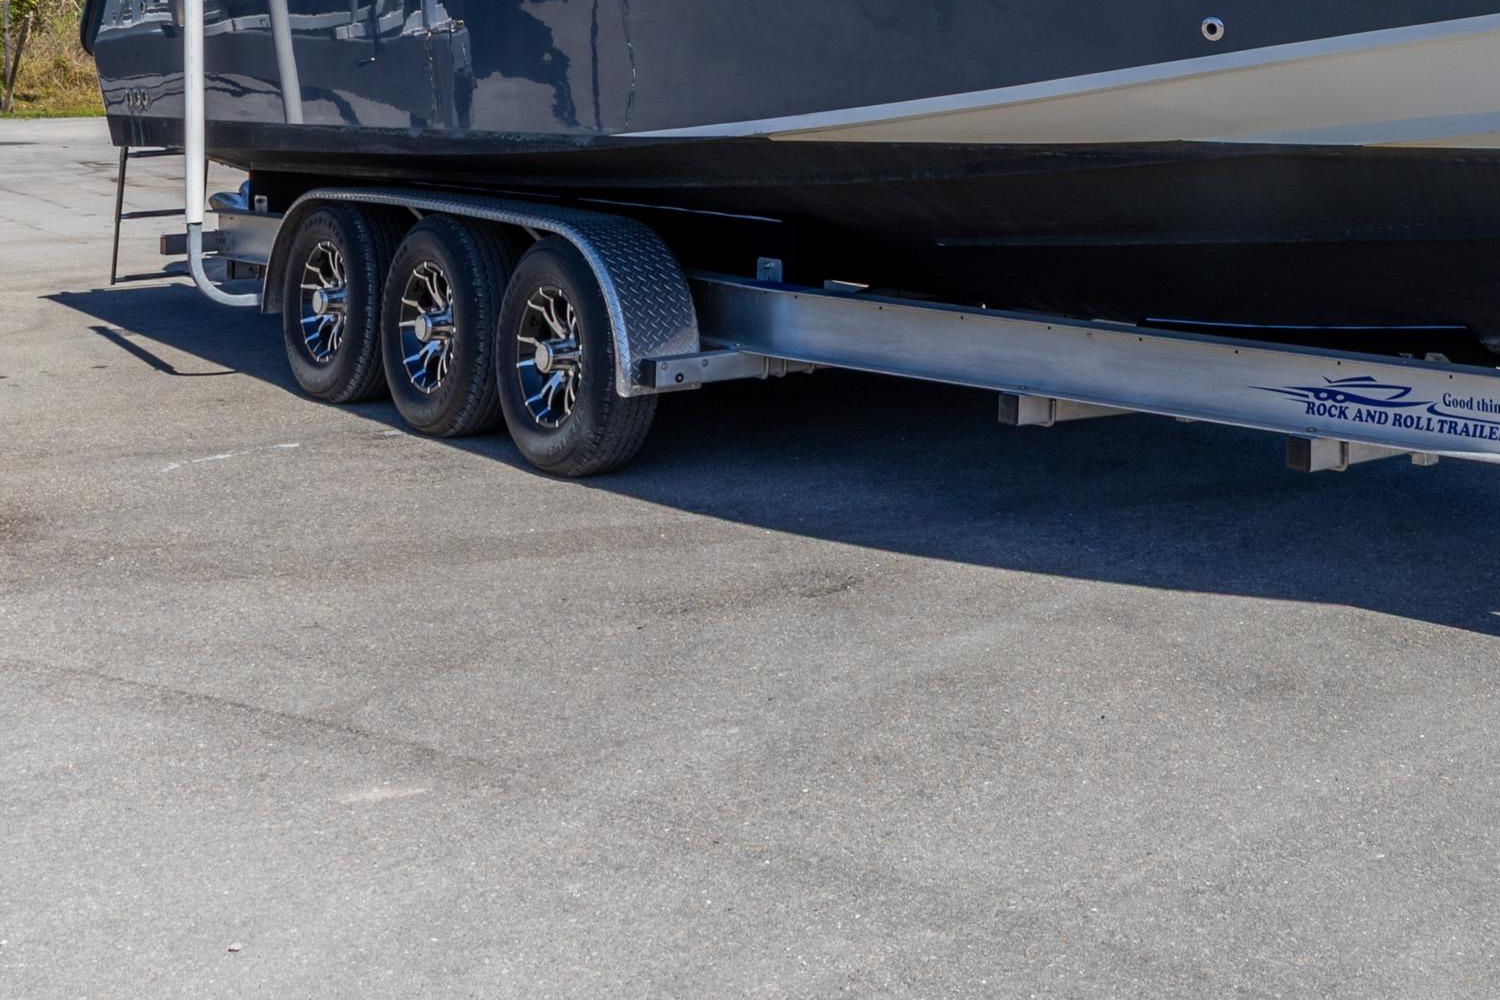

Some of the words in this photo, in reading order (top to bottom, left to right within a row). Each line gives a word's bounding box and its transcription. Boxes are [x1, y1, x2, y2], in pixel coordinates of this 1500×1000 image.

[1442, 392, 1473, 411] Good
[1305, 402, 1349, 420] ROCK
[1352, 408, 1389, 425] AND
[1392, 413, 1435, 432] ROLL
